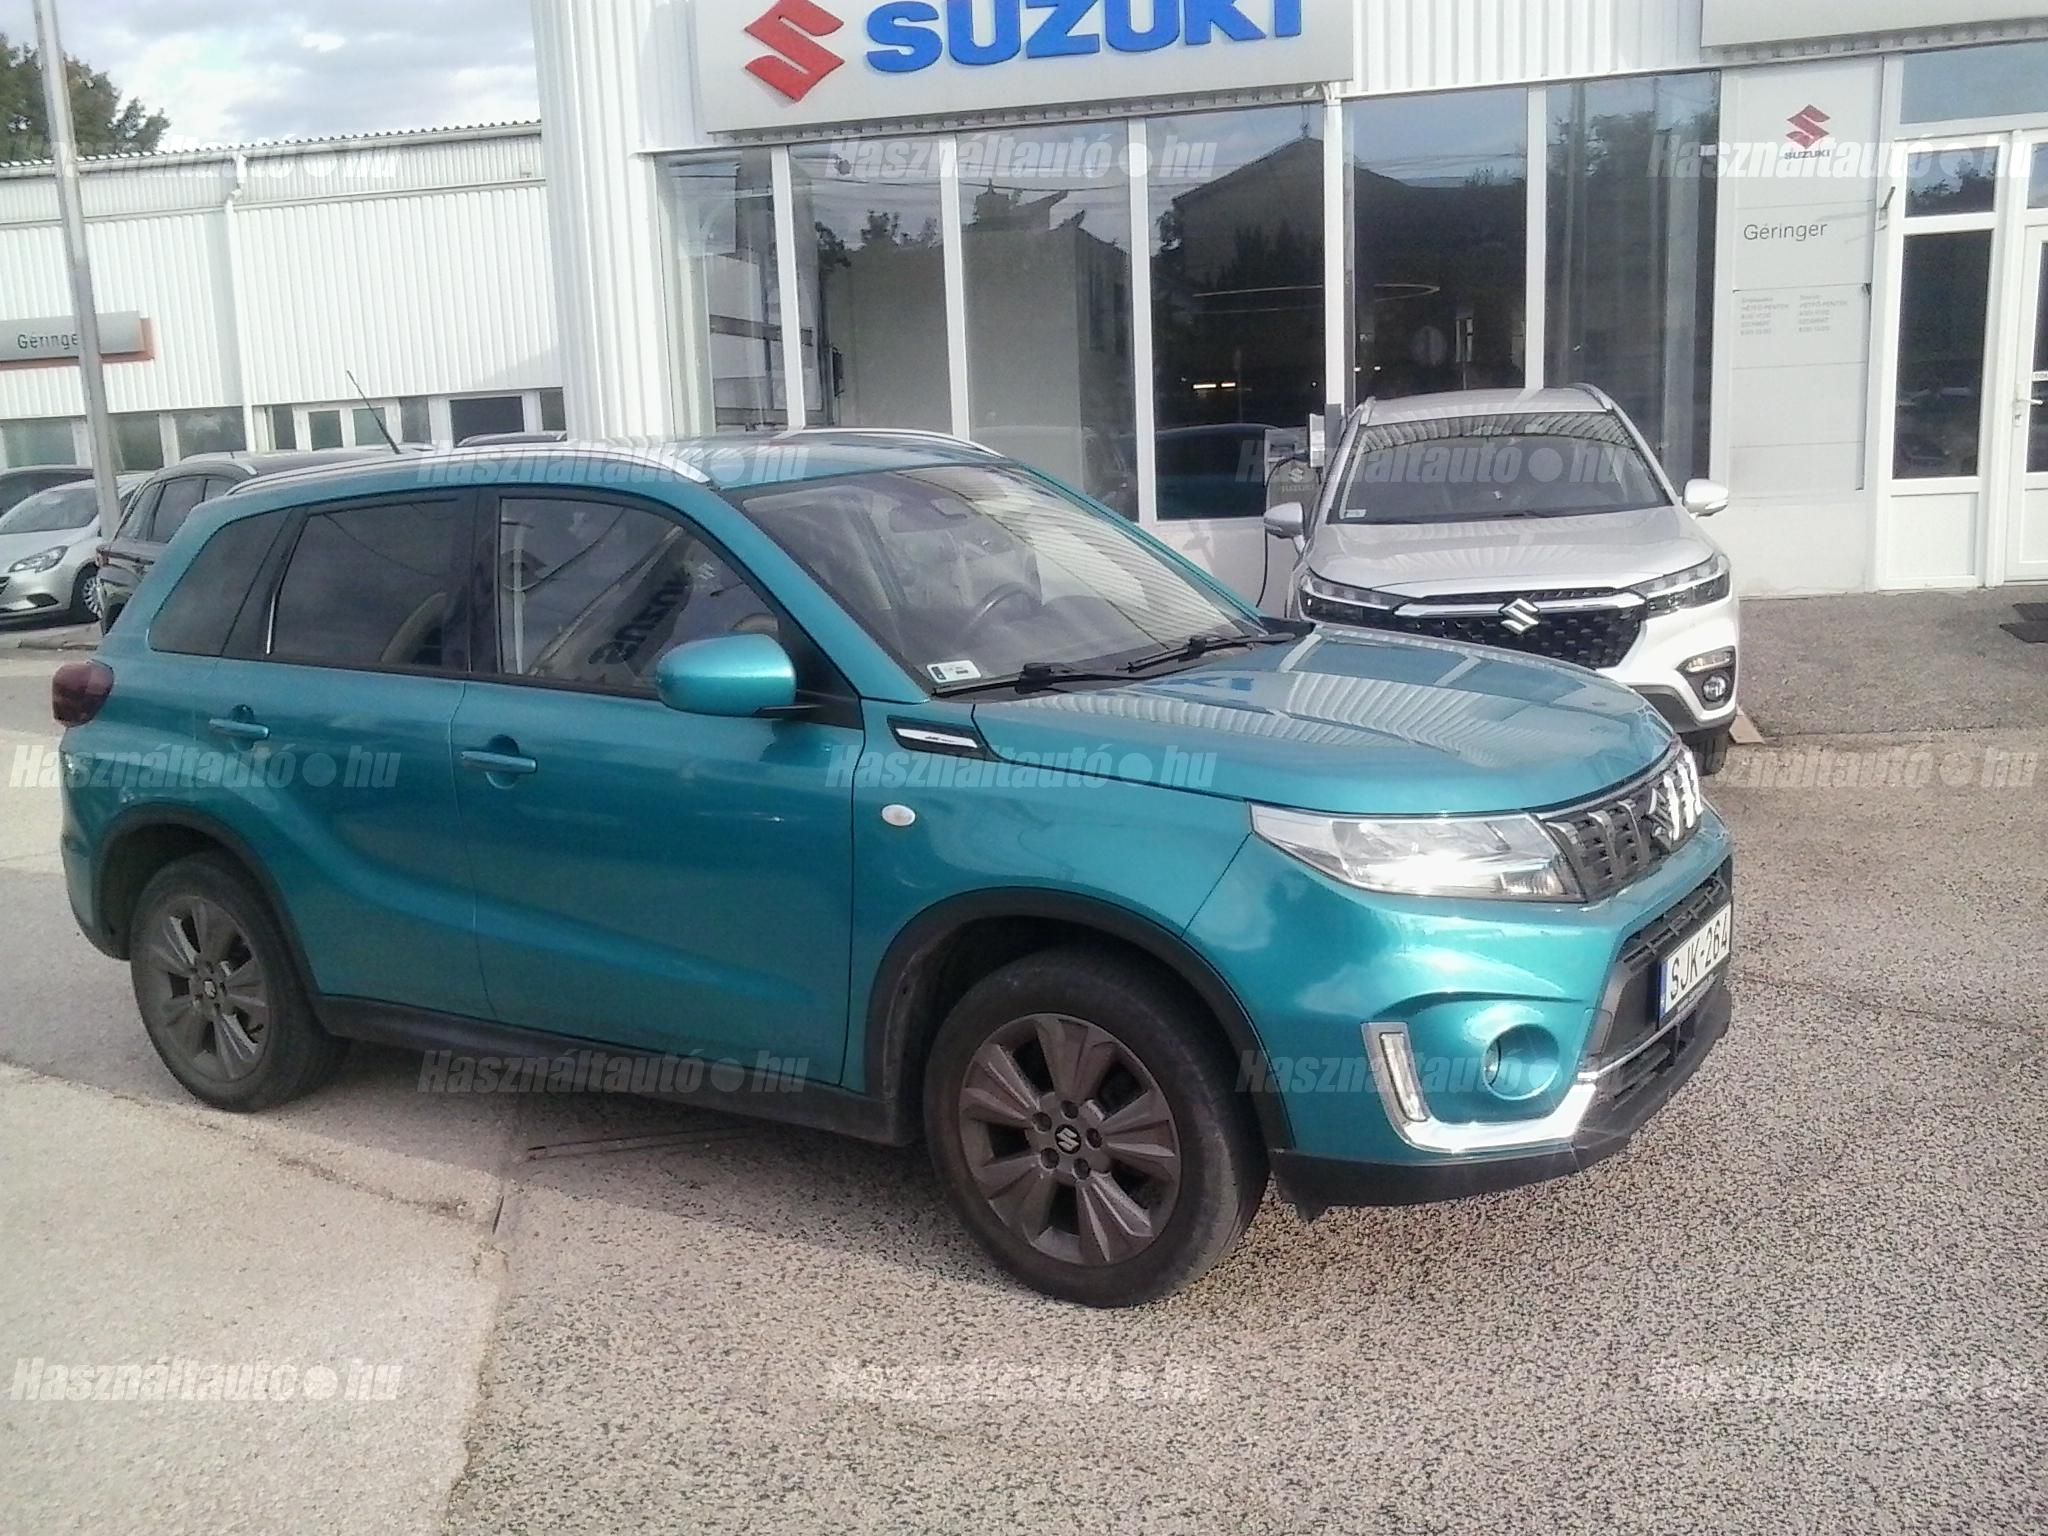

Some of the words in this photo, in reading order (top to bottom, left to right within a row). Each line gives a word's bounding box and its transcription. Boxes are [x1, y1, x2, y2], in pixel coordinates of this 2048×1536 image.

[867, 0, 1302, 73] SUZUKI
[1784, 149, 1831, 160] SUZUKI
[1743, 222, 1828, 242] Géringer
[1670, 913, 1728, 1000] SJK-264
